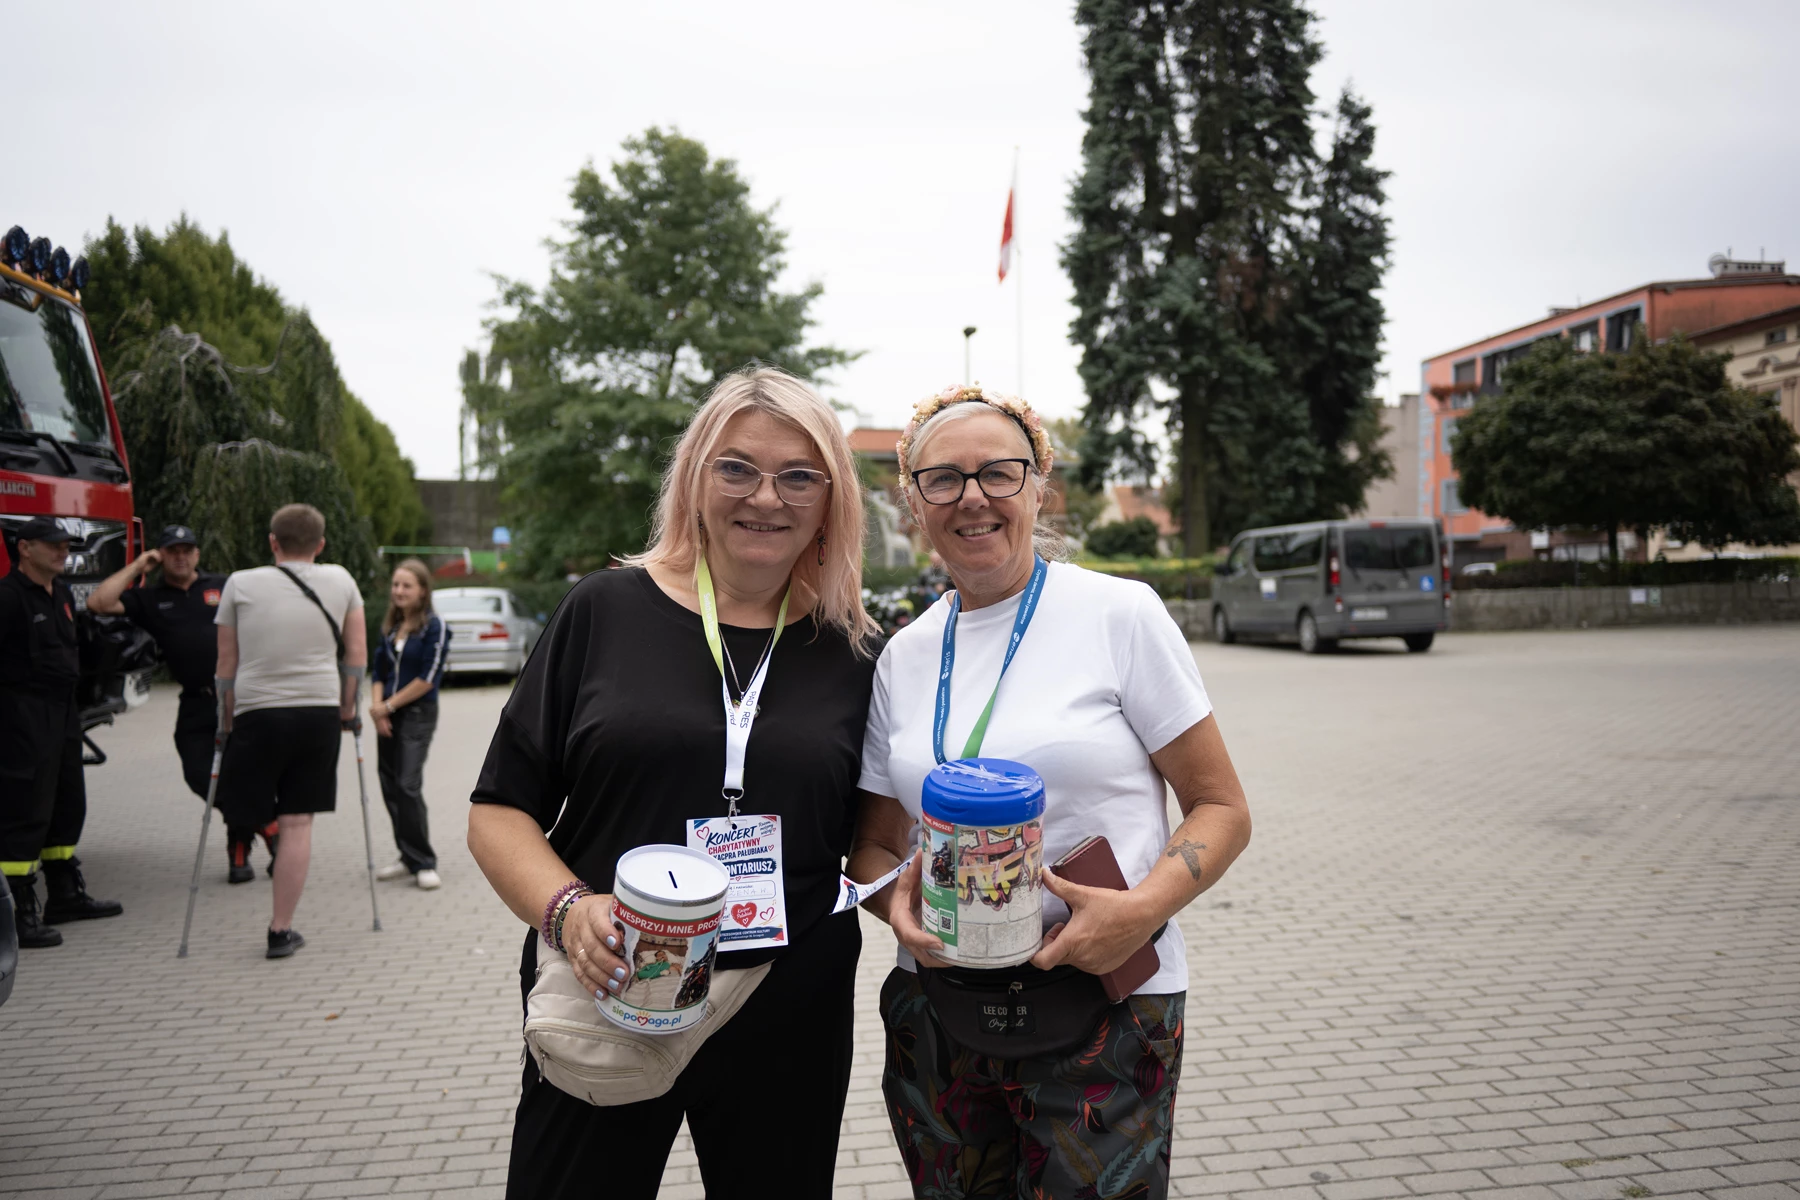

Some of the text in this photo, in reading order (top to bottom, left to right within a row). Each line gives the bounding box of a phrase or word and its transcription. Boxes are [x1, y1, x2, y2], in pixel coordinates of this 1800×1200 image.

[740, 711, 750, 728] RES
[705, 826, 757, 848] KONCERT
[708, 837, 761, 855] CHARYTATYWNY
[737, 846, 768, 858] PAŁUBIAKA
[726, 860, 773, 875] ONTARIUSZ
[619, 907, 664, 933] WESPRZYJ
[666, 925, 695, 935] MNIE,
[983, 1005, 1027, 1016] LEE COER
